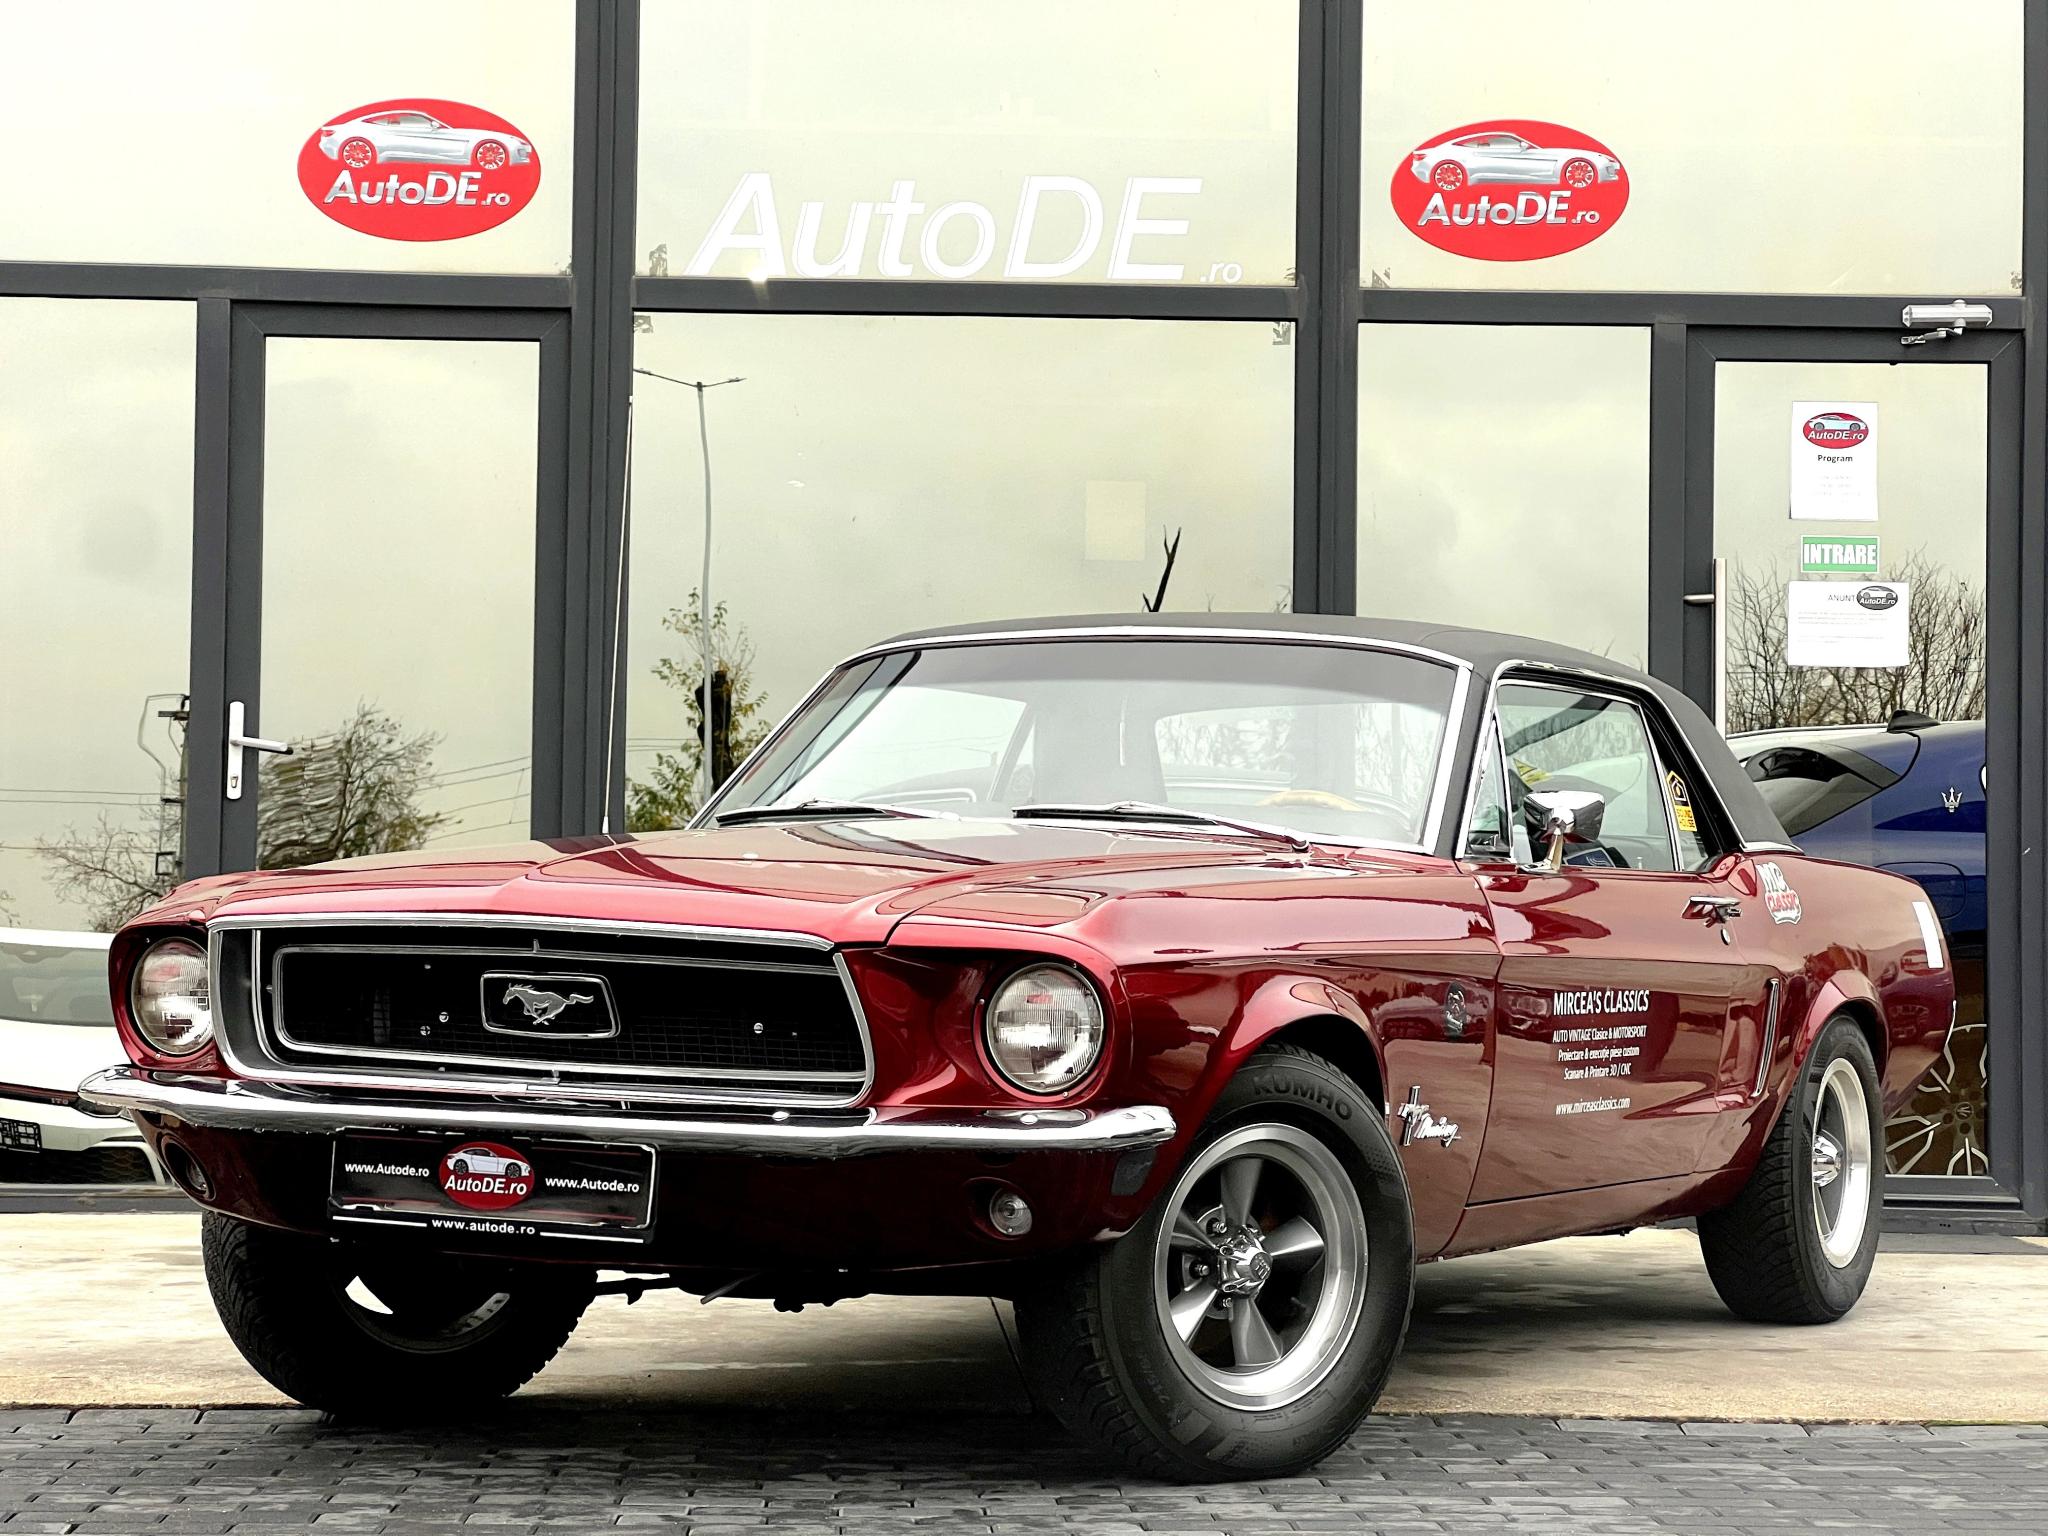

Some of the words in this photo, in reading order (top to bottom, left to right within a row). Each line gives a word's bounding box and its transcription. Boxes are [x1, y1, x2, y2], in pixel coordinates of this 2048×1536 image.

[1807, 430, 1865, 440] AutoDE.ro
[1817, 454, 1853, 463] Program
[1803, 543, 1877, 565] INTRARE
[1553, 990, 1602, 1016] MIRCEA'S
[1603, 989, 1650, 1013] CLASSICS
[1552, 1030, 1568, 1043] AUTO
[1568, 1028, 1592, 1042] VINTAGE
[1613, 1025, 1648, 1039] MOTORSPORT
[1253, 1073, 1353, 1121] KUMHO
[345, 1161, 430, 1178] www.Autode.ro
[444, 1174, 528, 1196] AutoDE.ro
[545, 1175, 640, 1193] www.Autode.ro
[431, 1217, 536, 1235] www.autode.ro
